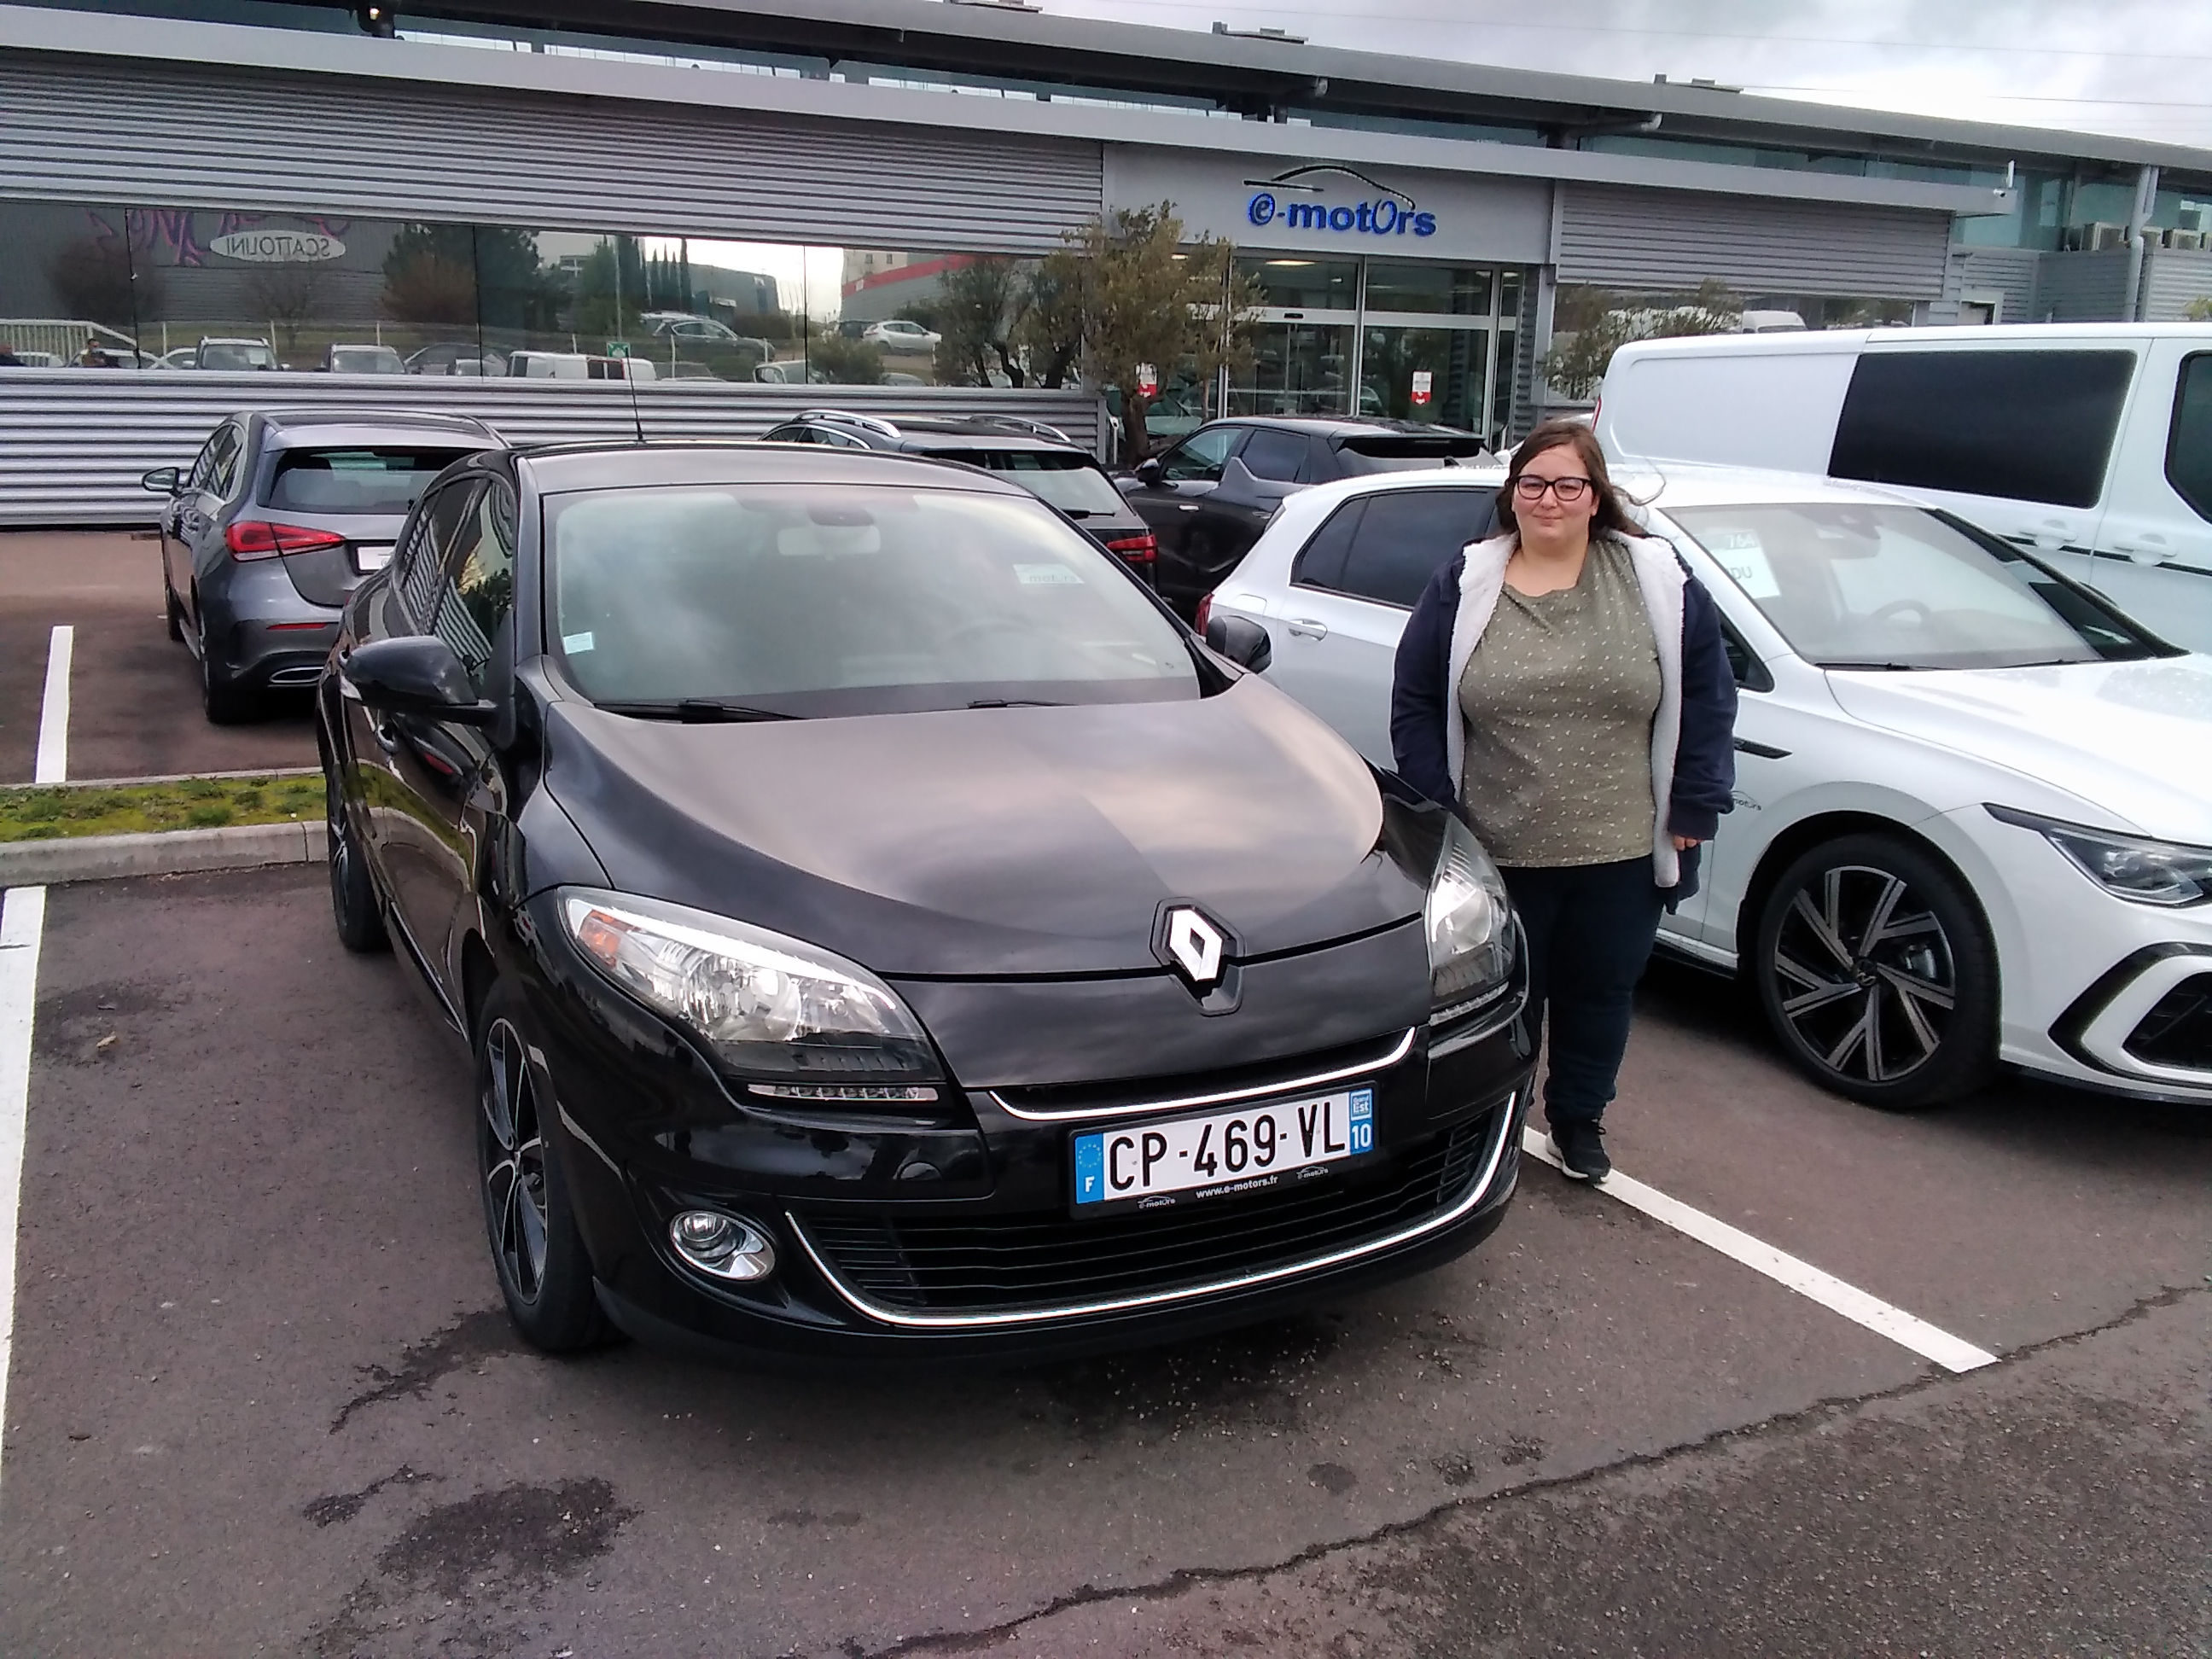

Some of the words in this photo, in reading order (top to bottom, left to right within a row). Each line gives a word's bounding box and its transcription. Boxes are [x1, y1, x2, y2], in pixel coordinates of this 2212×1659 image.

[1353, 1101, 1370, 1113] Est
[1352, 1123, 1371, 1150] 10
[1086, 1176, 1095, 1192] F
[1196, 1174, 1278, 1199] www.e-motors.fr
